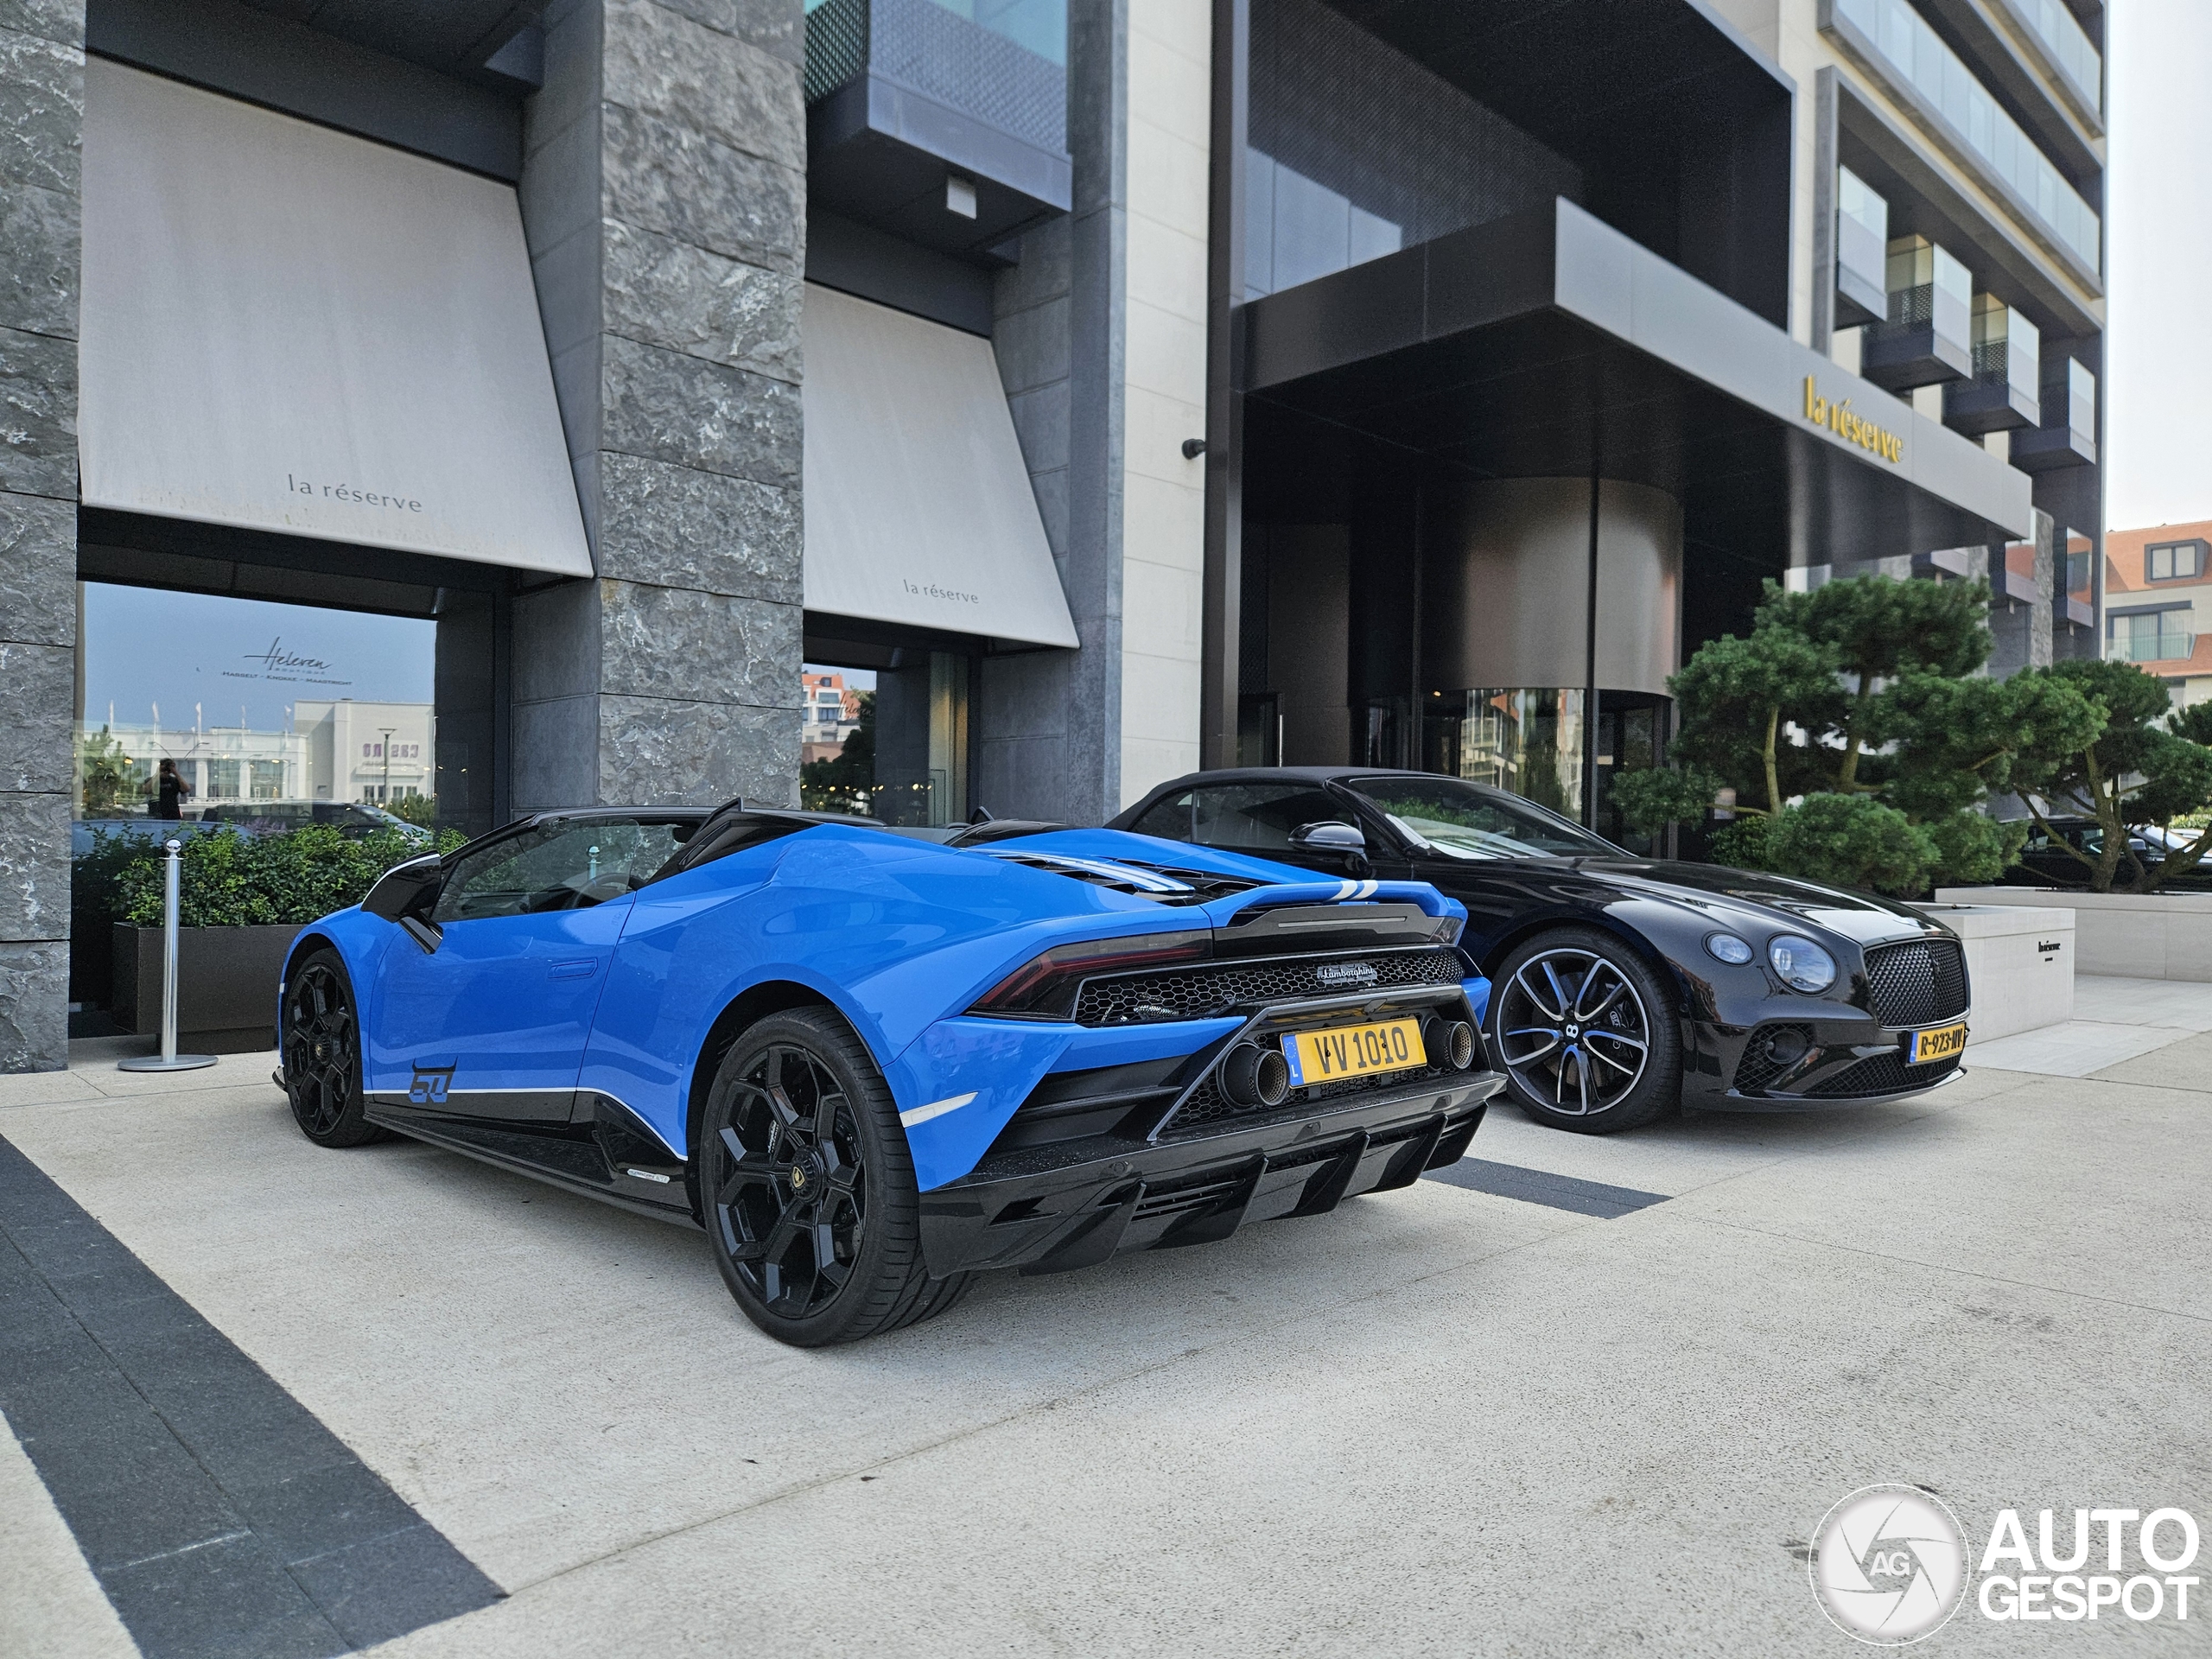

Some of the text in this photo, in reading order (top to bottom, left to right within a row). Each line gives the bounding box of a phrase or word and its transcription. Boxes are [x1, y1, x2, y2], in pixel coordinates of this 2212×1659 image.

[1803, 373, 1904, 463] la réserve
[288, 474, 423, 513] la réserve
[903, 579, 980, 604] la réserve
[1320, 965, 1373, 979] Lamborghini
[1313, 1026, 1408, 1074] VV 1010
[409, 1067, 455, 1103] 60
[1292, 1062, 1299, 1077] L
